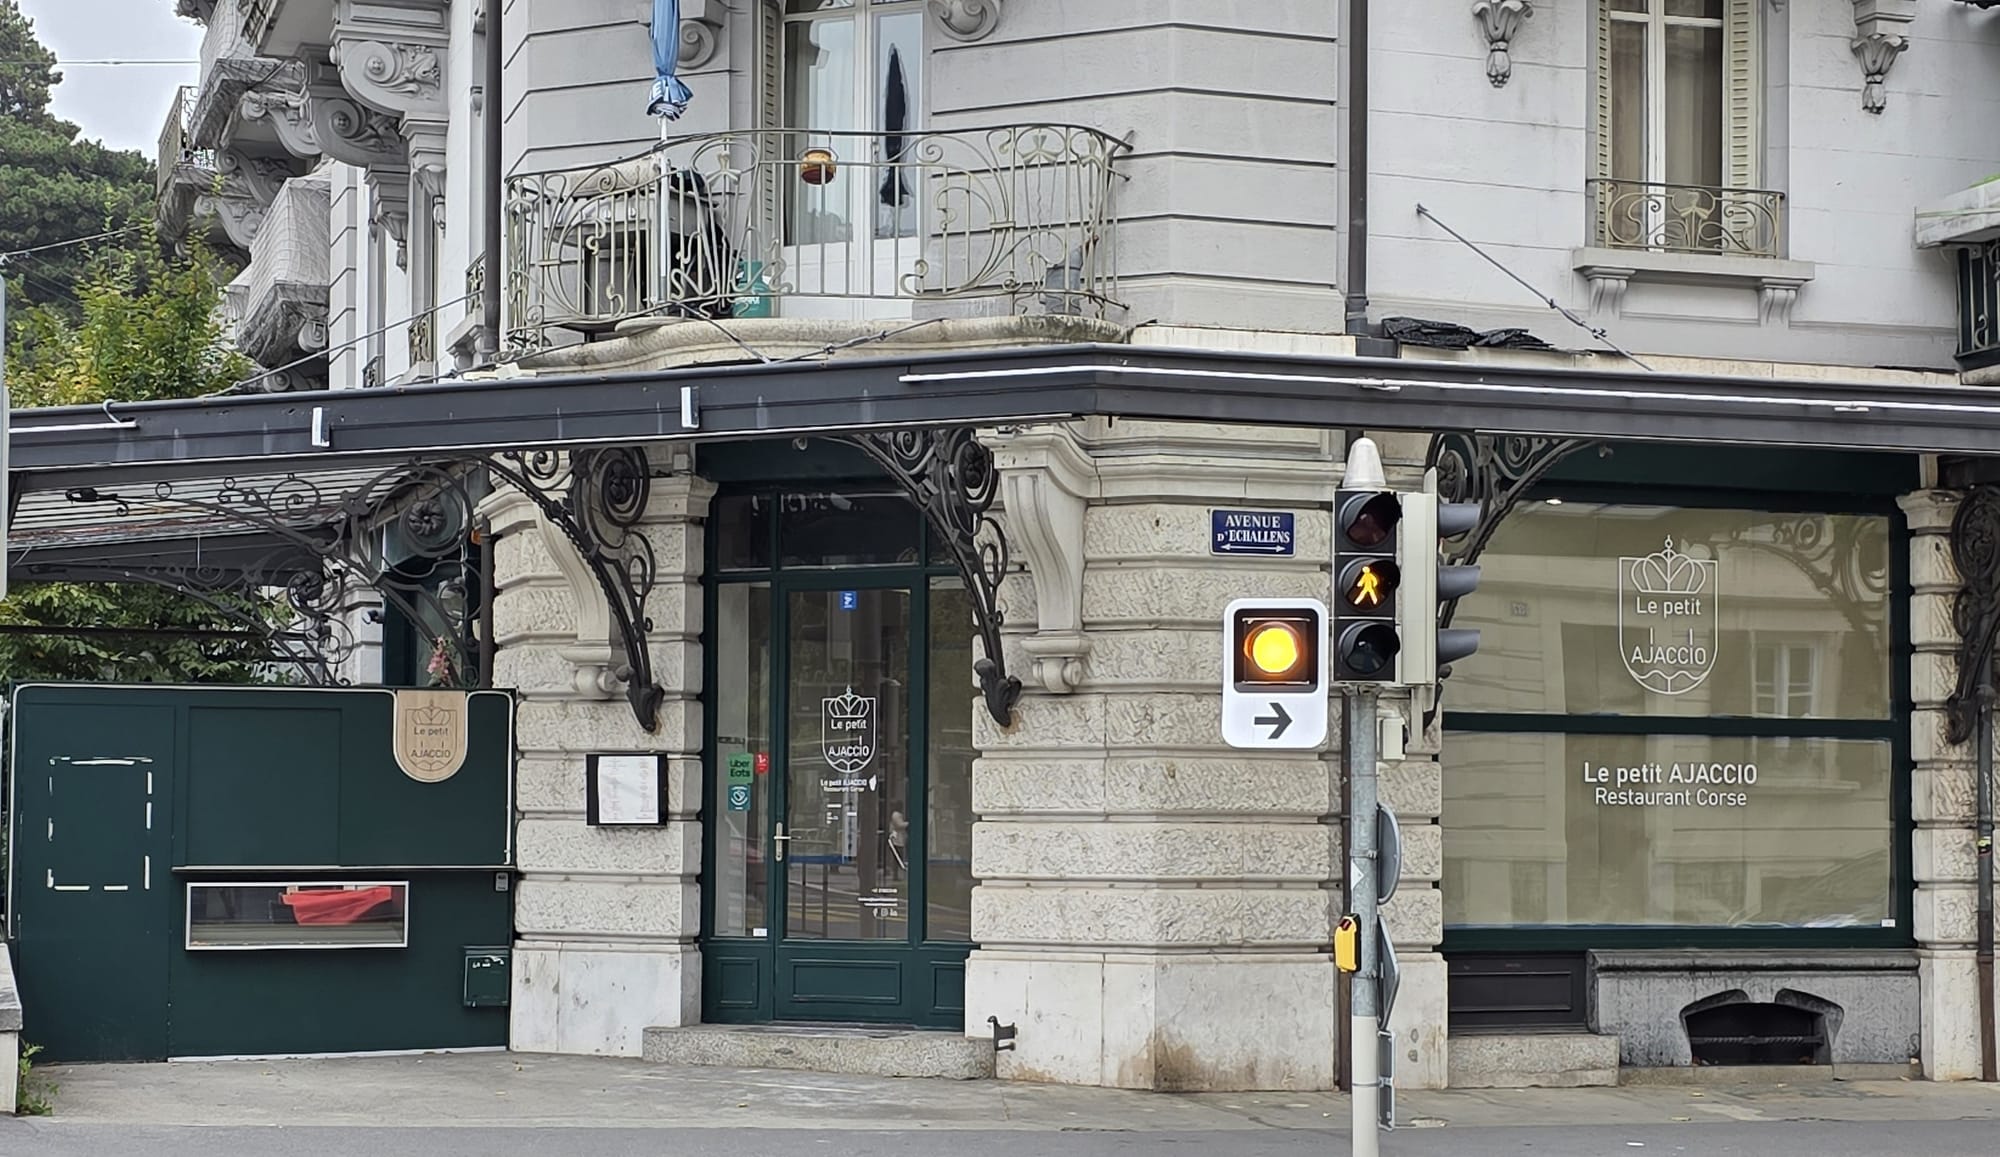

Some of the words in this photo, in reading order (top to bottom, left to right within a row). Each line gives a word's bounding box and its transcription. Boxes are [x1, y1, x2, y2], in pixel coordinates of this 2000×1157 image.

[1225, 514, 1281, 528] AVENUE
[1636, 596, 1658, 614] Le
[1663, 598, 1702, 619] petit
[1630, 645, 1707, 665] AJACCIO
[413, 726, 425, 735] Le
[428, 727, 448, 736] petit
[831, 719, 843, 729] Le
[845, 719, 867, 731] petit
[411, 749, 451, 758] AJACCIO
[828, 745, 870, 757] AJACCIO
[730, 768, 750, 777] Eats
[1584, 761, 1610, 783] Le
[1616, 763, 1662, 788] petit
[1668, 763, 1758, 784] AJACCIO
[1595, 787, 1692, 805] Restaurant
[1696, 788, 1748, 806] Corse
